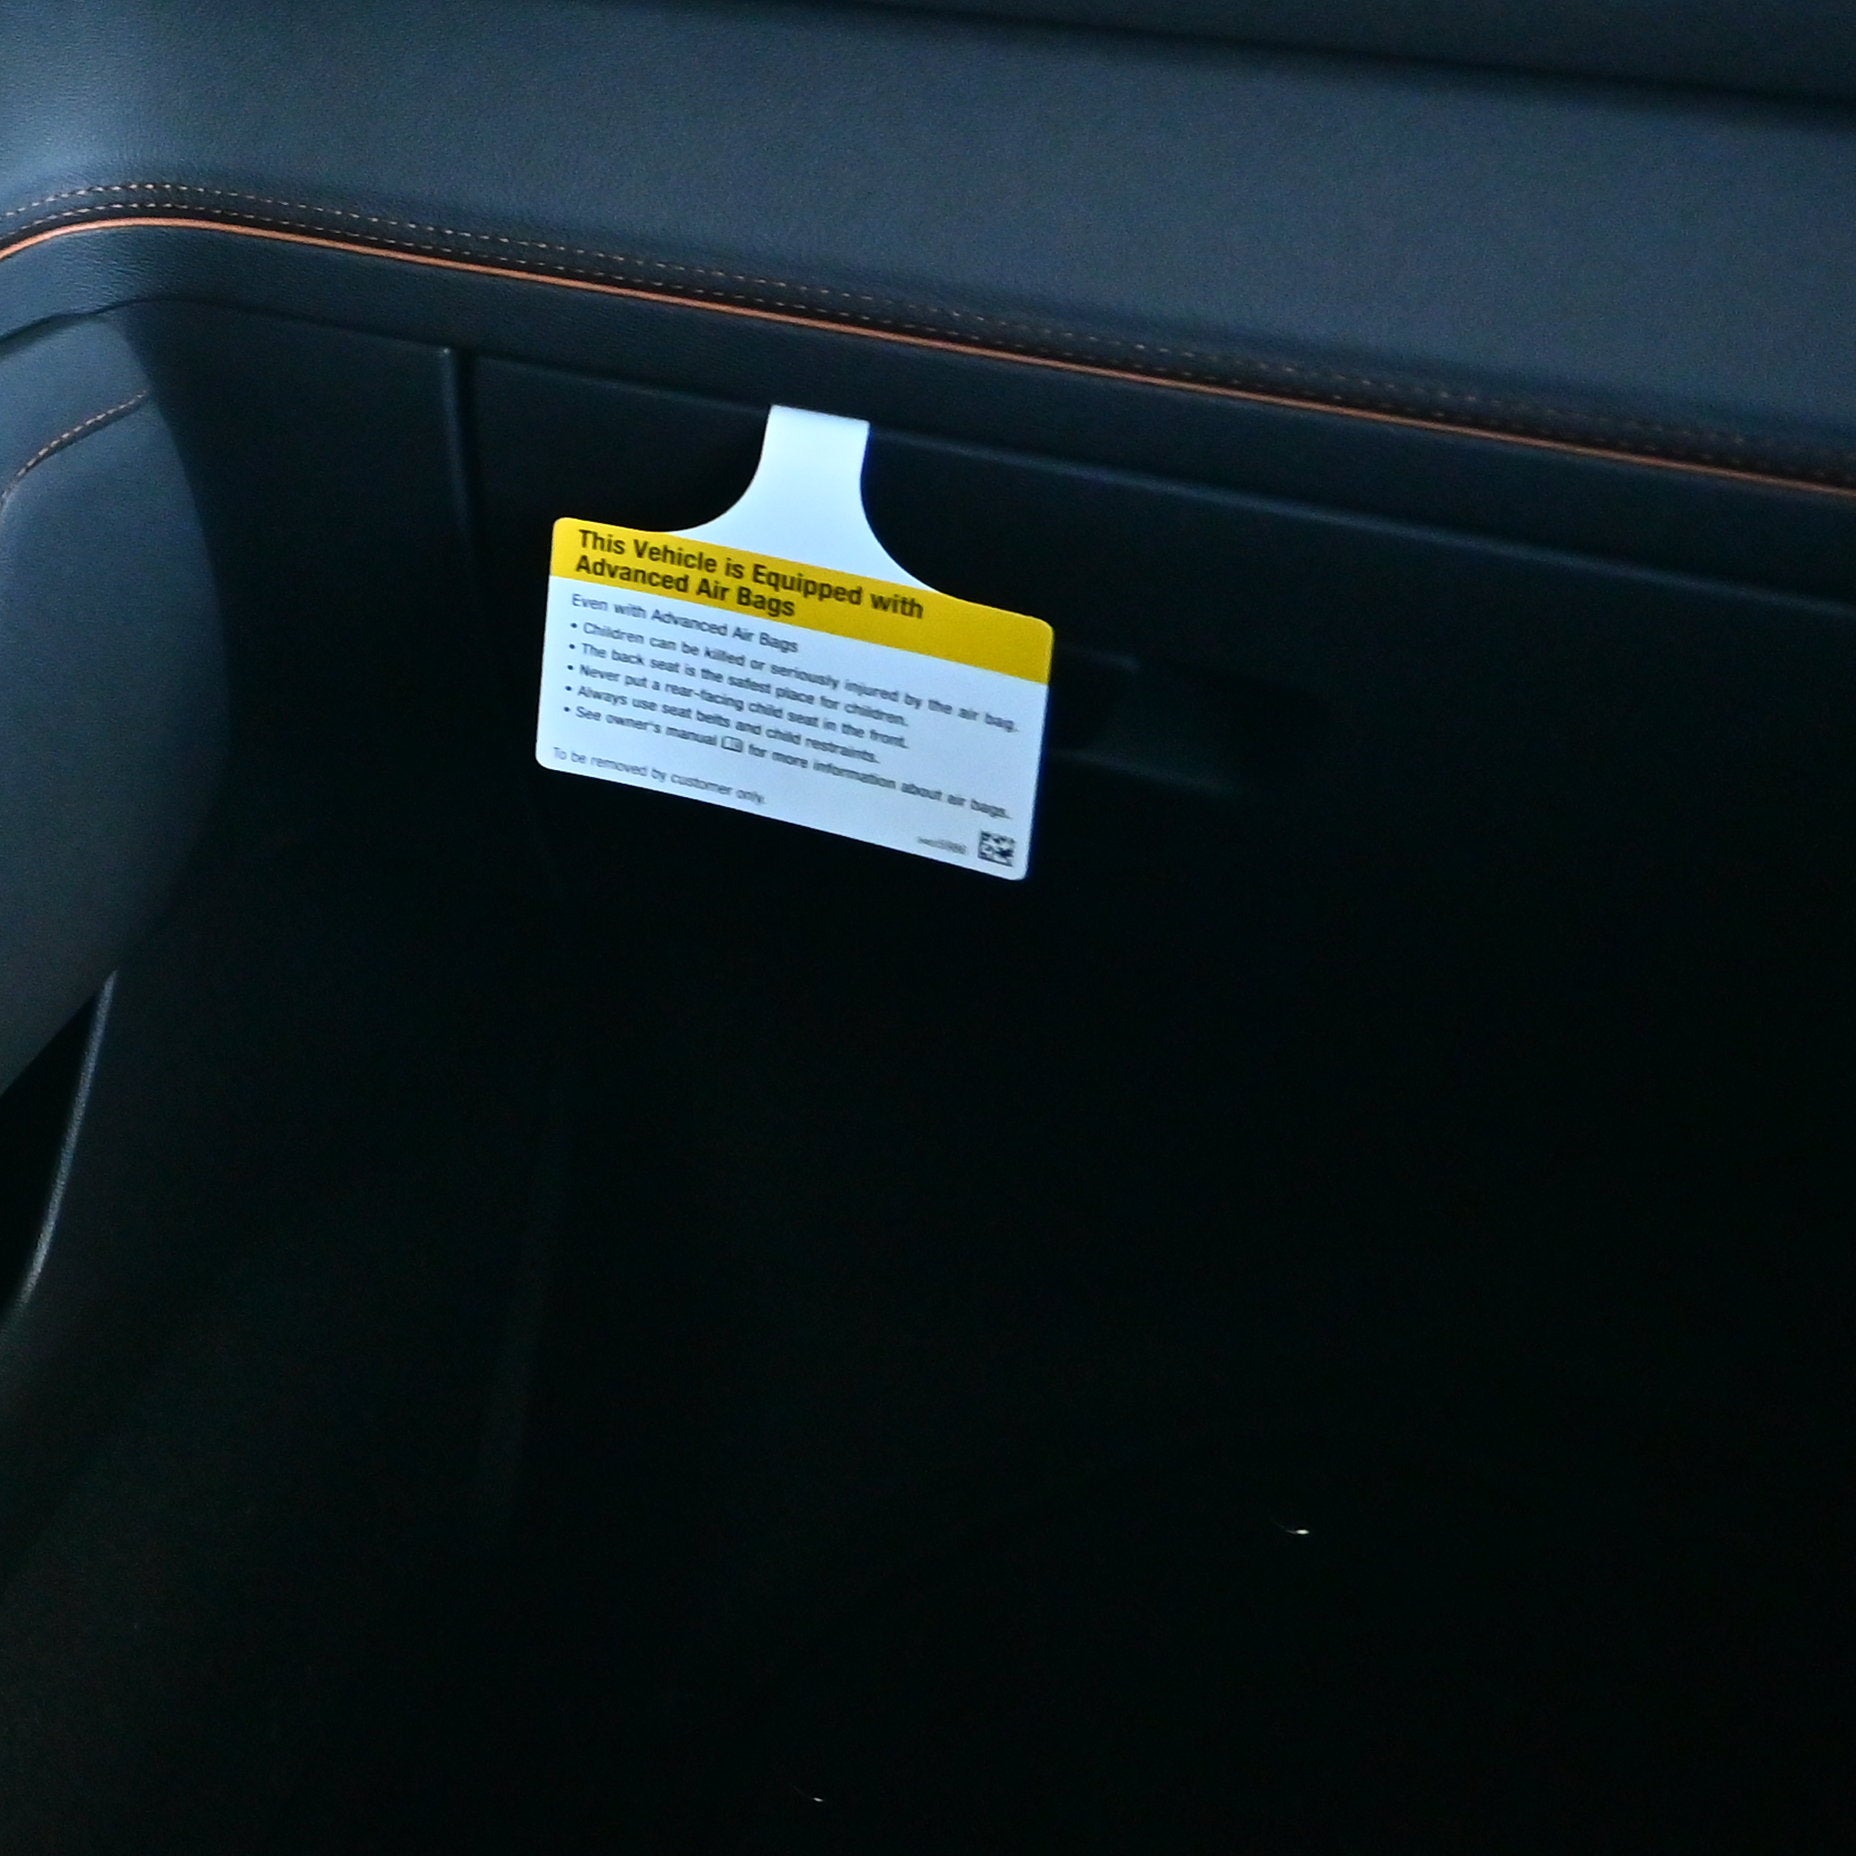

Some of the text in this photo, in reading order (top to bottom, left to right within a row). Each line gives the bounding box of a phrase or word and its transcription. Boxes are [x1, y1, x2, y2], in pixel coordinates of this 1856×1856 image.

[575, 554, 796, 618] Advanced Air Bags
[579, 529, 925, 620] This Vehicle is Equipped with
[572, 593, 799, 654] Even with Advanced Air Bags
[579, 664, 620, 682] Never
[624, 674, 648, 689] put
[651, 680, 661, 691] a
[664, 683, 745, 712] rear-facing
[748, 701, 784, 719] child
[787, 711, 820, 728] seat
[822, 716, 837, 732] in
[841, 722, 866, 739] the
[581, 643, 607, 659] The
[611, 648, 645, 666] back
[650, 658, 680, 674] seat
[684, 663, 697, 678] is
[700, 667, 724, 683] the
[727, 675, 772, 695] safest
[775, 687, 815, 706] place
[819, 695, 840, 710] for
[583, 622, 645, 645] Children
[649, 637, 677, 651] can
[681, 641, 700, 656] be
[704, 645, 746, 667] killed
[750, 659, 766, 671] or
[770, 664, 840, 690] seriously
[904, 692, 923, 710] by
[928, 698, 953, 715] the
[578, 685, 628, 706] Always
[632, 698, 659, 712] use
[661, 703, 693, 720] seat
[735, 720, 762, 736] and
[765, 727, 802, 746] child
[552, 746, 568, 761] To
[570, 751, 587, 765] be
[590, 756, 649, 778] removed
[650, 767, 668, 784] by
[670, 773, 734, 796] customer
[575, 705, 602, 722] See
[665, 726, 718, 747] manual
[747, 743, 767, 758] for
[772, 751, 809, 769] more
[813, 759, 897, 790] information
[900, 782, 943, 802] about
